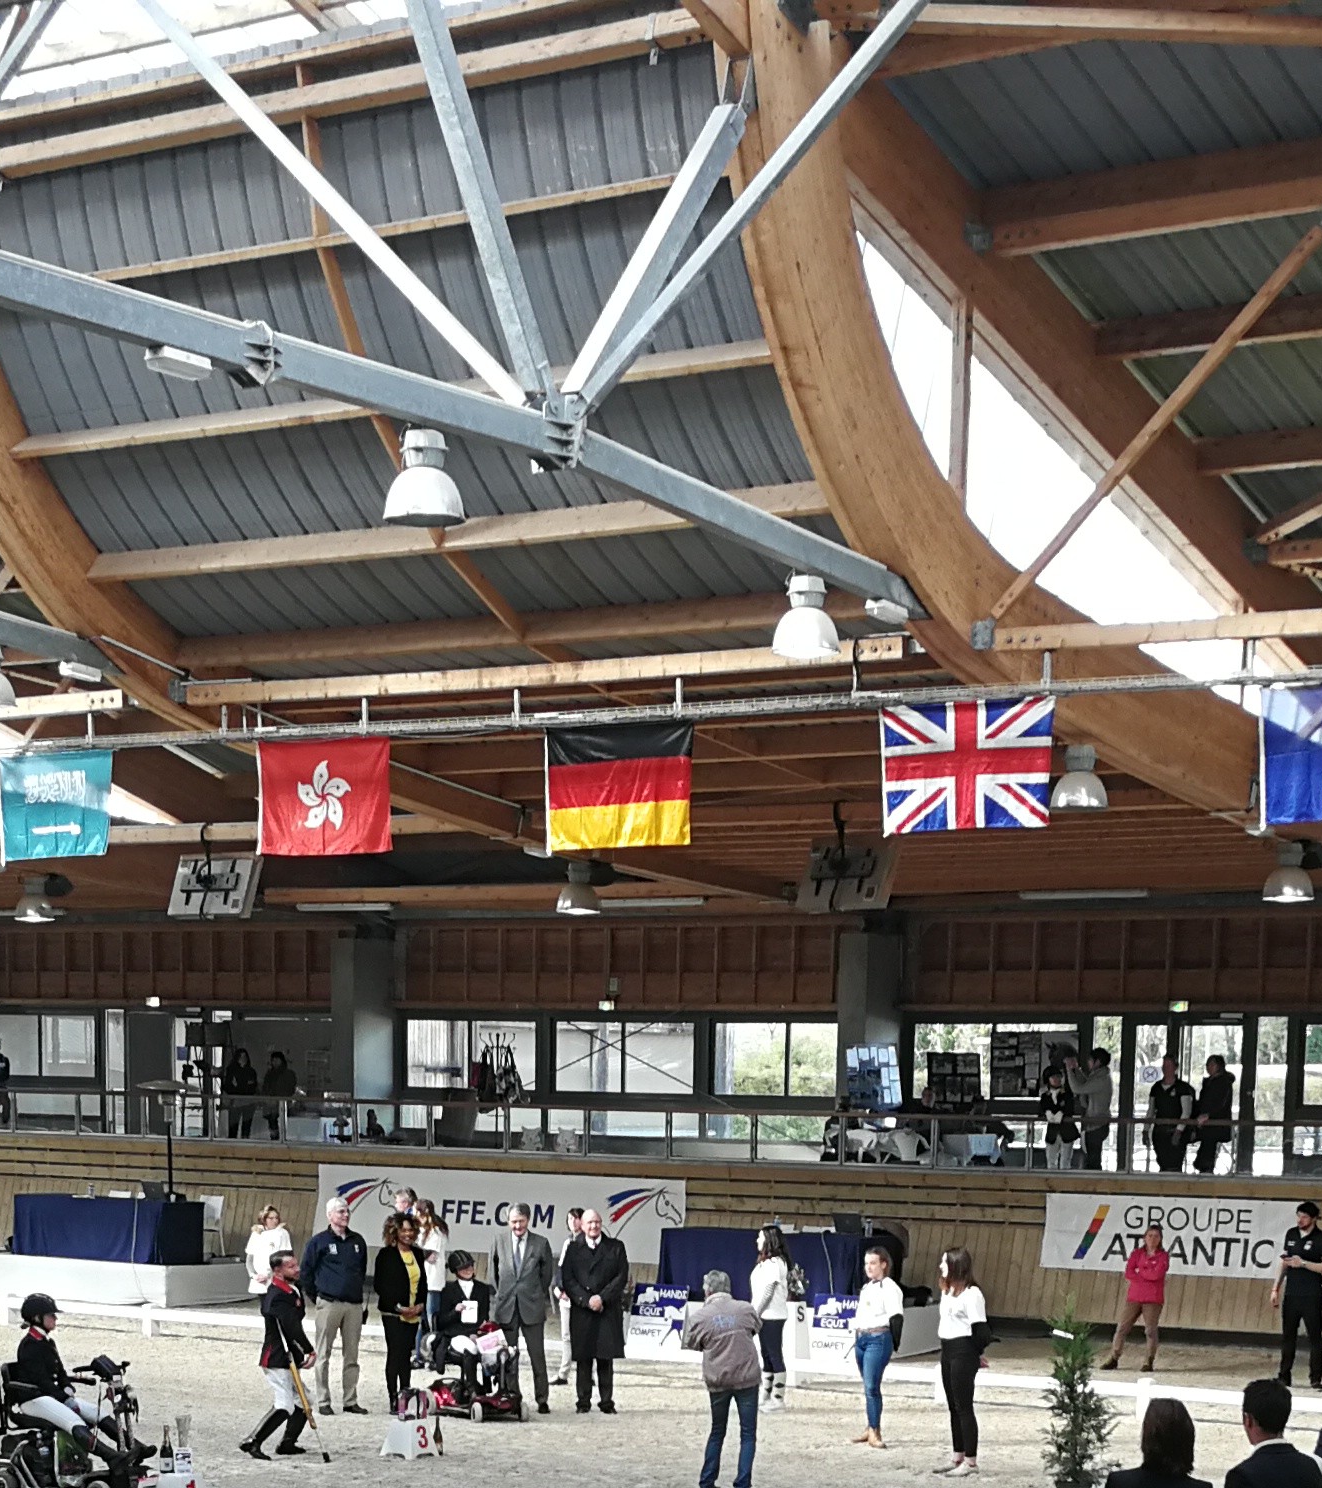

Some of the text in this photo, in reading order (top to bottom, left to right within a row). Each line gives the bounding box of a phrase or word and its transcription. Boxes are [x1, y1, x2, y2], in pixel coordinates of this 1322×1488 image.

[441, 1199, 555, 1229] FFE.CM
[1124, 1205, 1253, 1234] GROUPE
[1102, 1233, 1275, 1269] ATANTIC
[660, 1288, 688, 1299] HANDI
[639, 1306, 663, 1316] EQUI
[797, 1306, 805, 1322] S
[630, 1327, 662, 1337] COMPET
[811, 1340, 845, 1350] COMPET
[416, 1425, 429, 1449] 3
